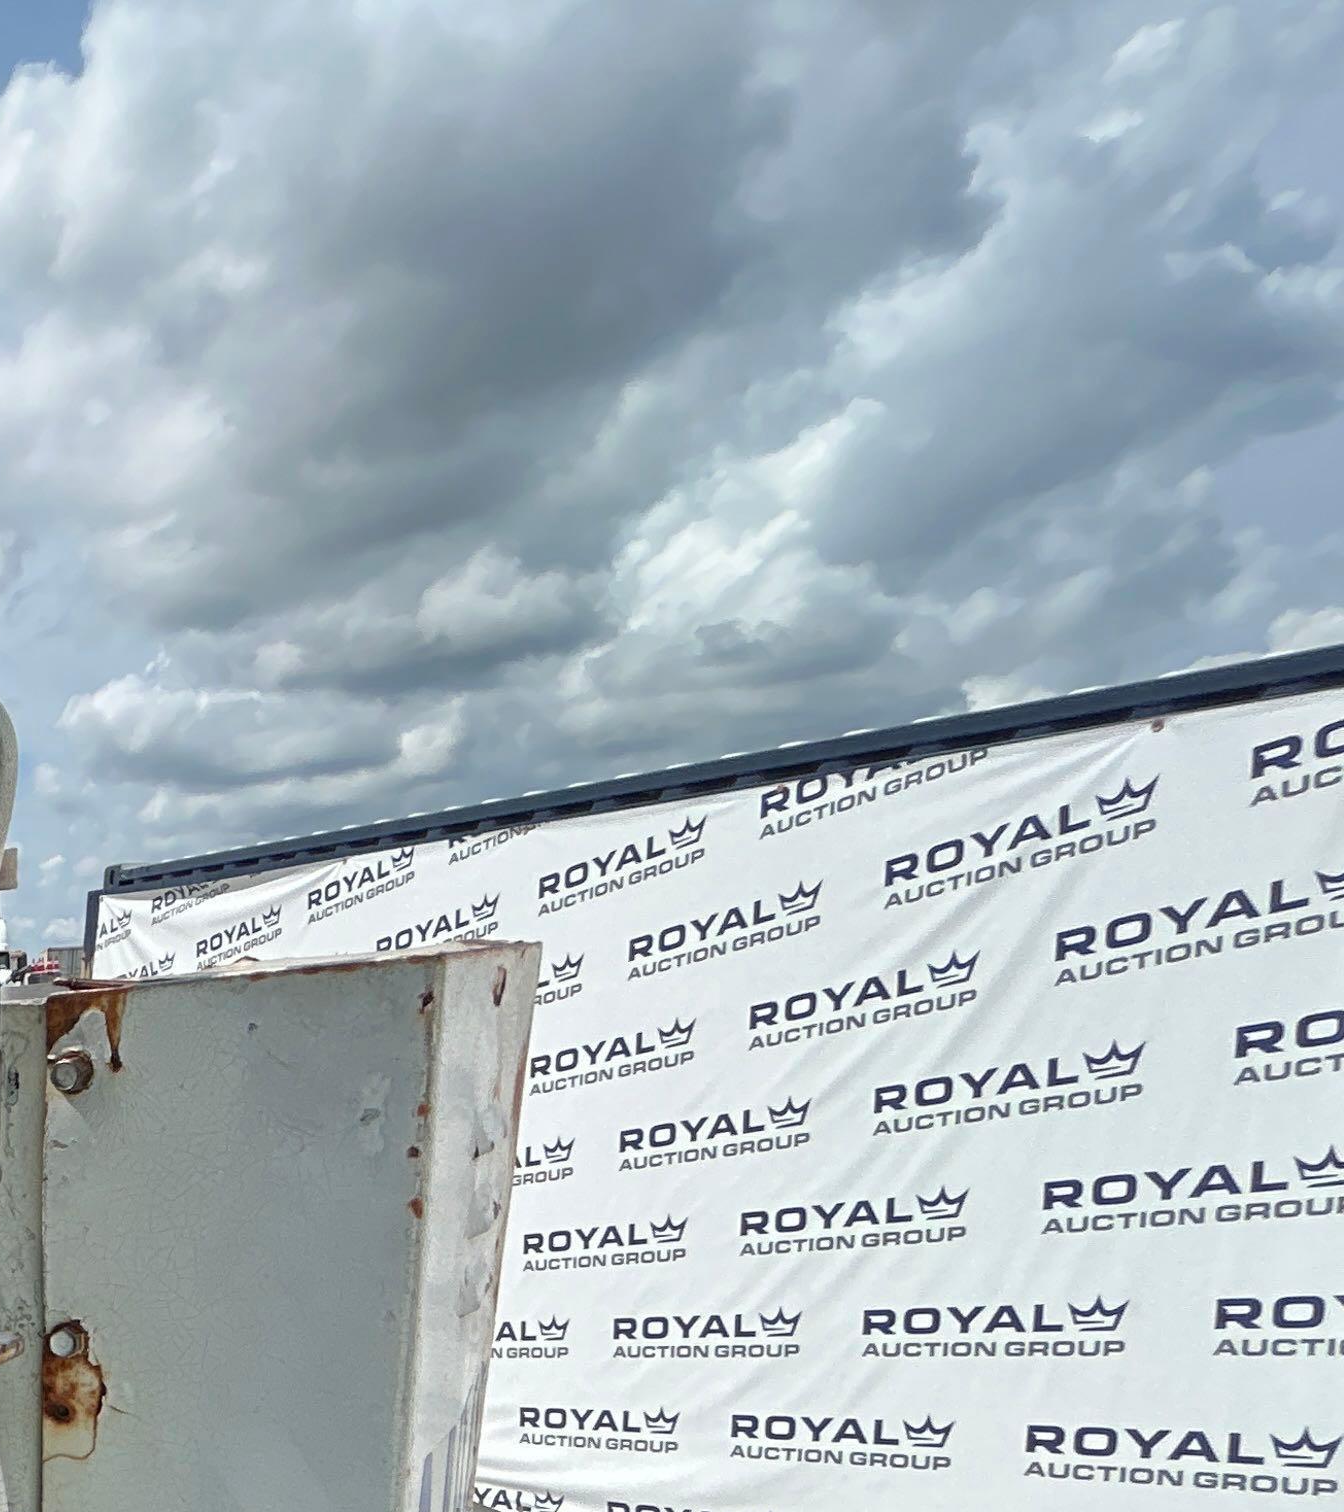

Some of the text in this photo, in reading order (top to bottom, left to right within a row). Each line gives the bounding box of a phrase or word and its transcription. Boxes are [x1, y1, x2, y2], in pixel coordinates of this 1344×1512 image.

[759, 750, 989, 839] AUCTION GROUP
[884, 805, 1092, 887] ROYAL
[884, 819, 1158, 909] AUCTION GROUP
[308, 860, 391, 910] ROYAL
[538, 836, 666, 899] ROYAL
[538, 848, 705, 917] AUCTION GROUP
[308, 871, 415, 924] AUCTION GROUP
[196, 917, 262, 958] ROYAL
[376, 908, 470, 952] ROYAL
[628, 899, 776, 962] ROYAL
[1055, 879, 1310, 962] ROYAL
[196, 927, 283, 971] AUCTION GROUP
[627, 915, 822, 981] AUCTION GROUP
[1055, 910, 1344, 987] AUCTION GROU
[534, 983, 582, 1005] ROUP
[750, 968, 925, 1030] ROYAL
[749, 989, 978, 1051] AUCTION GROUP
[529, 1050, 695, 1096] AUCTION GROUP
[530, 1032, 656, 1078] ROYAL
[1233, 1053, 1344, 1086] AUCT
[874, 1057, 1079, 1114] ROYAL
[619, 1109, 765, 1152] ROYAL
[873, 1083, 1144, 1136] AUCTION GROUP
[618, 1132, 811, 1171] AUCTION GROUP
[1043, 1160, 1288, 1210] ROYAL
[740, 1197, 913, 1236] ROYAL
[1041, 1197, 1344, 1235] AUCTION GROU
[522, 1247, 687, 1271] AUCTION GROUP
[523, 1223, 648, 1255] ROYAL
[739, 1226, 968, 1256] AUCTION GROUP
[613, 1314, 756, 1340] ROYAL
[862, 1304, 1064, 1335] ROYAL
[507, 1347, 569, 1358] GROUP
[612, 1344, 800, 1358] AUCTION GROUP
[862, 1339, 1126, 1357] AUCTION GROUP
[1212, 1338, 1344, 1357] AUCTI
[519, 1407, 641, 1433] ROYAL
[731, 1414, 899, 1445] ROYAL
[519, 1433, 679, 1453] AUCTION GROUP
[730, 1445, 952, 1470] AUCTION GROUP
[1025, 1424, 1265, 1465] ROYAL
[1024, 1461, 1340, 1496] AUCTION GROUP
